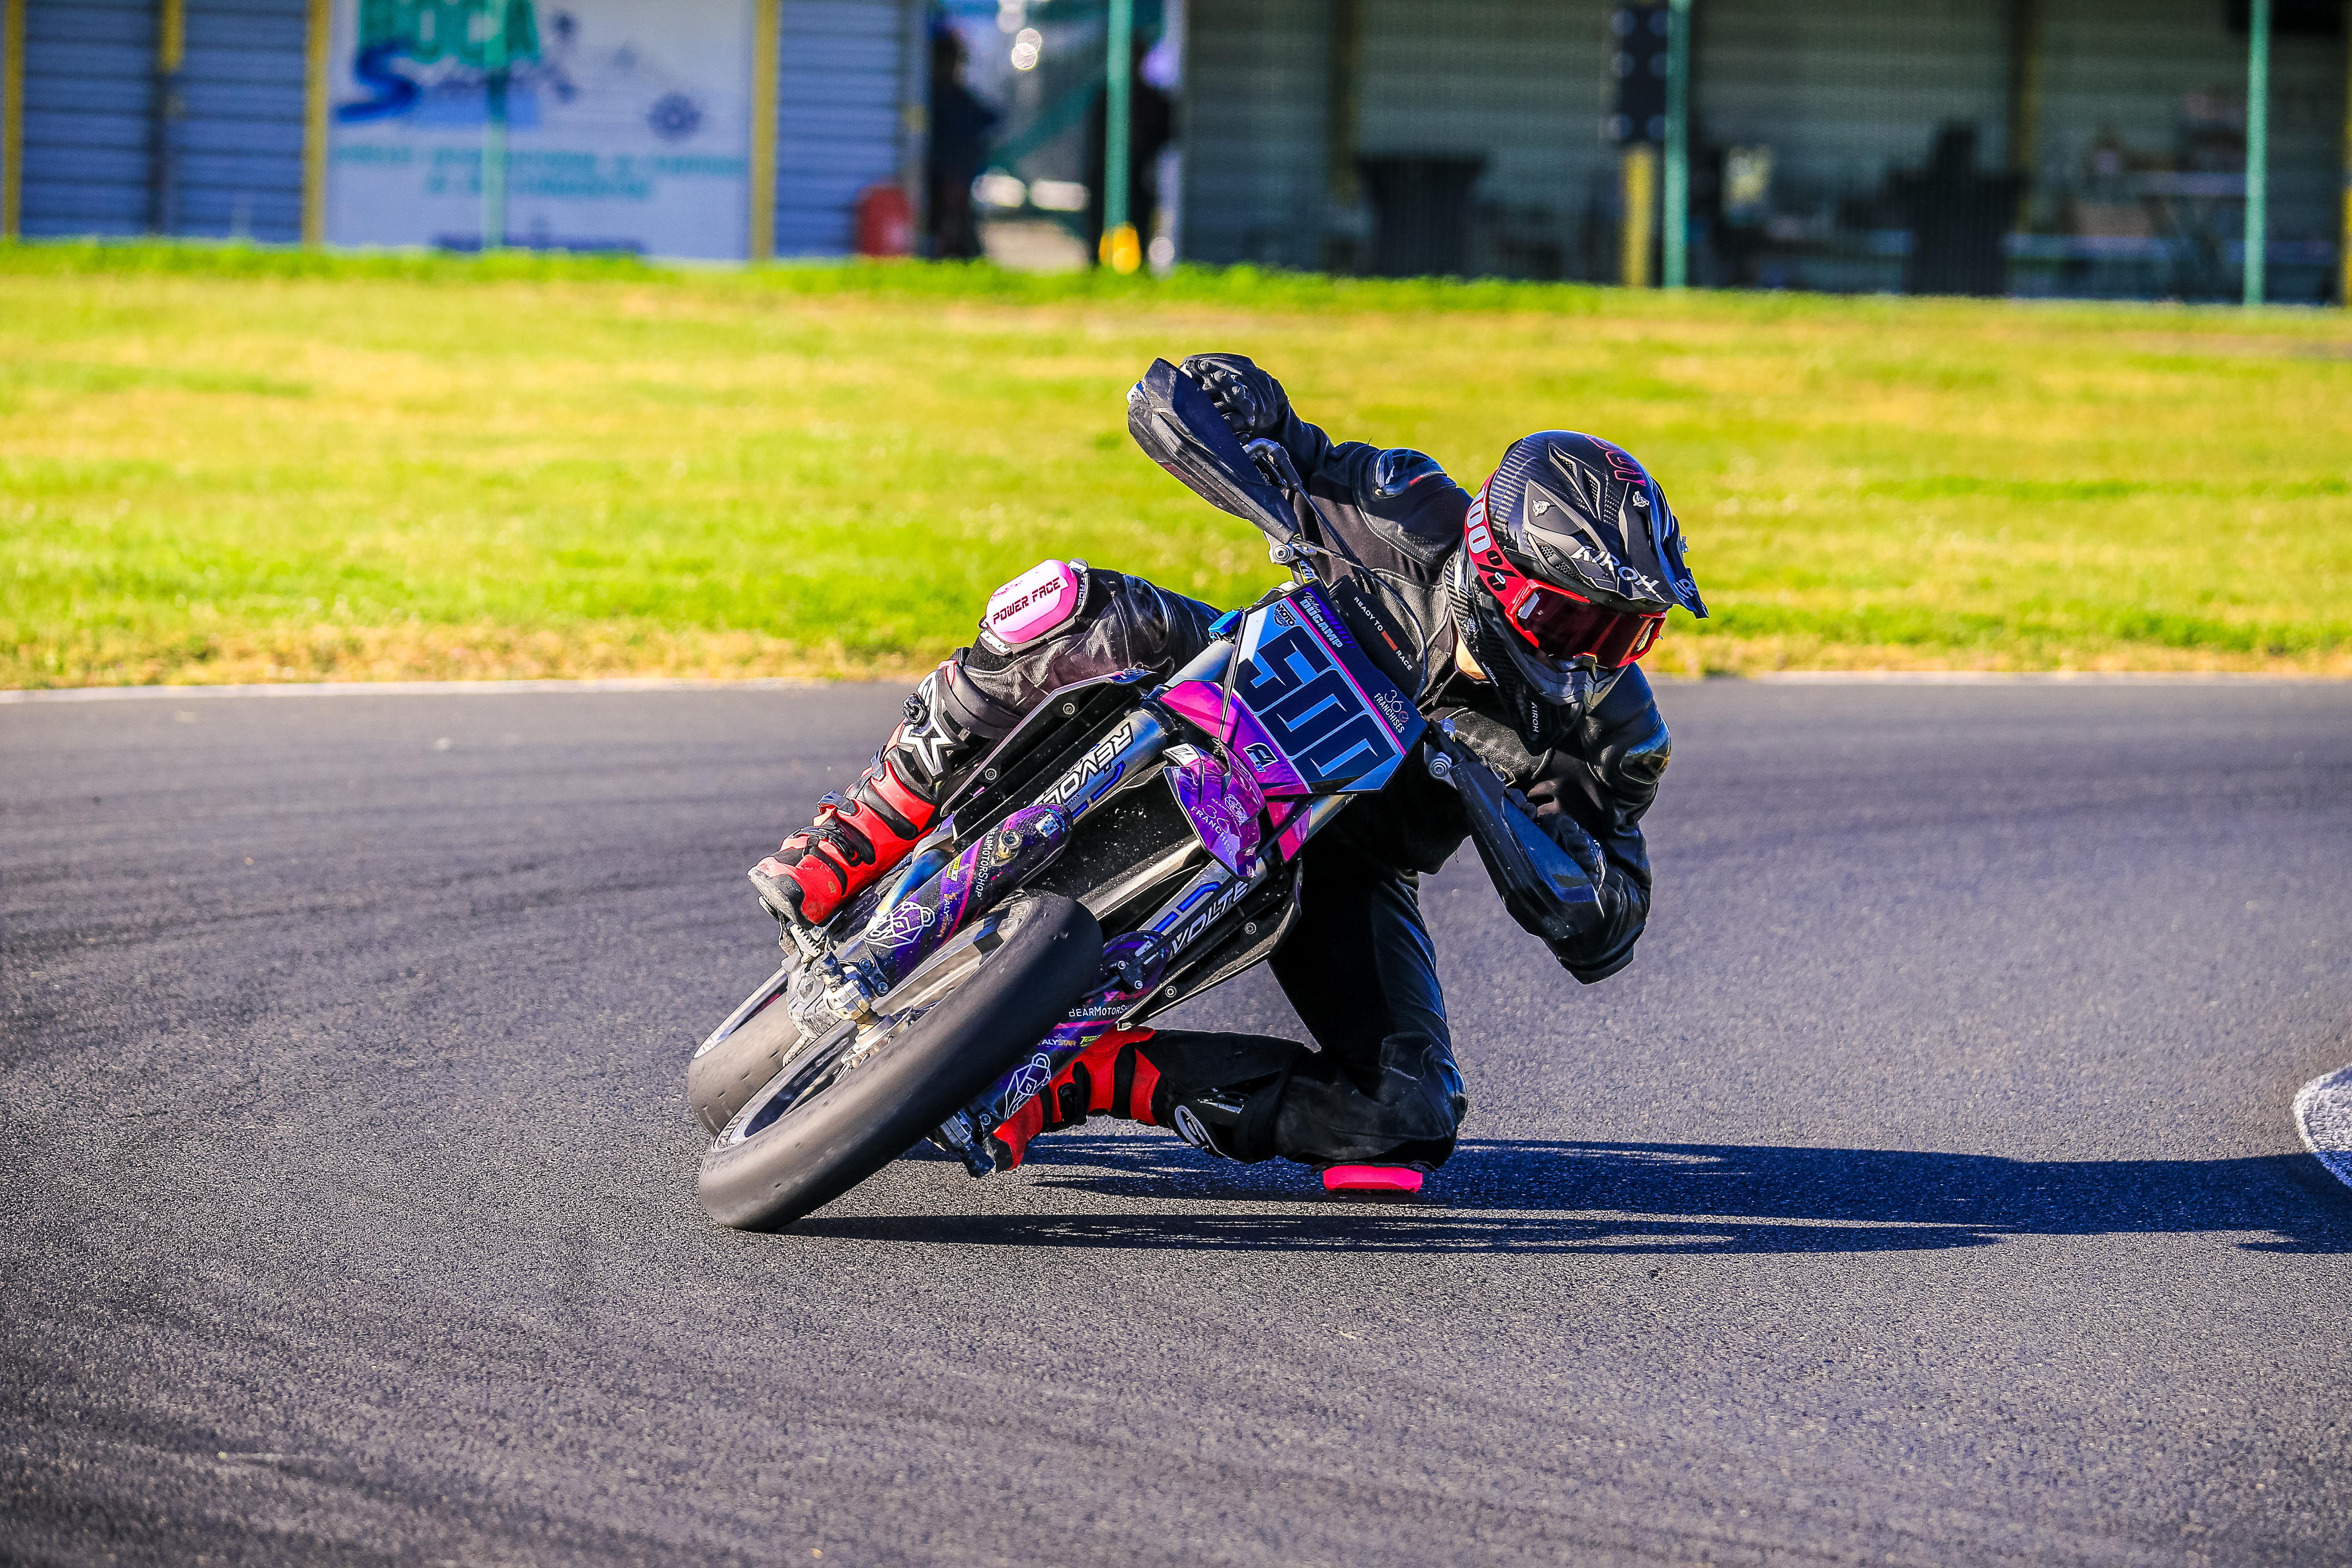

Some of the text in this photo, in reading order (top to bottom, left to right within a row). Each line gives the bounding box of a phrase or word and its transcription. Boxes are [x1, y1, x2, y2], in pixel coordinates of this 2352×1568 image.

[993, 577, 1061, 625] POWER FACE
[1275, 603, 1295, 626] MOTO
[1299, 598, 1343, 647] DUCAMP
[1354, 597, 1413, 671] READY TO RACE
[1233, 626, 1396, 783] 500
[1374, 692, 1405, 733] FRANCHISES
[1531, 701, 1539, 733] AIROH
[1034, 721, 1134, 805] RÉVOL
[1190, 805, 1236, 865] FRANCHISES
